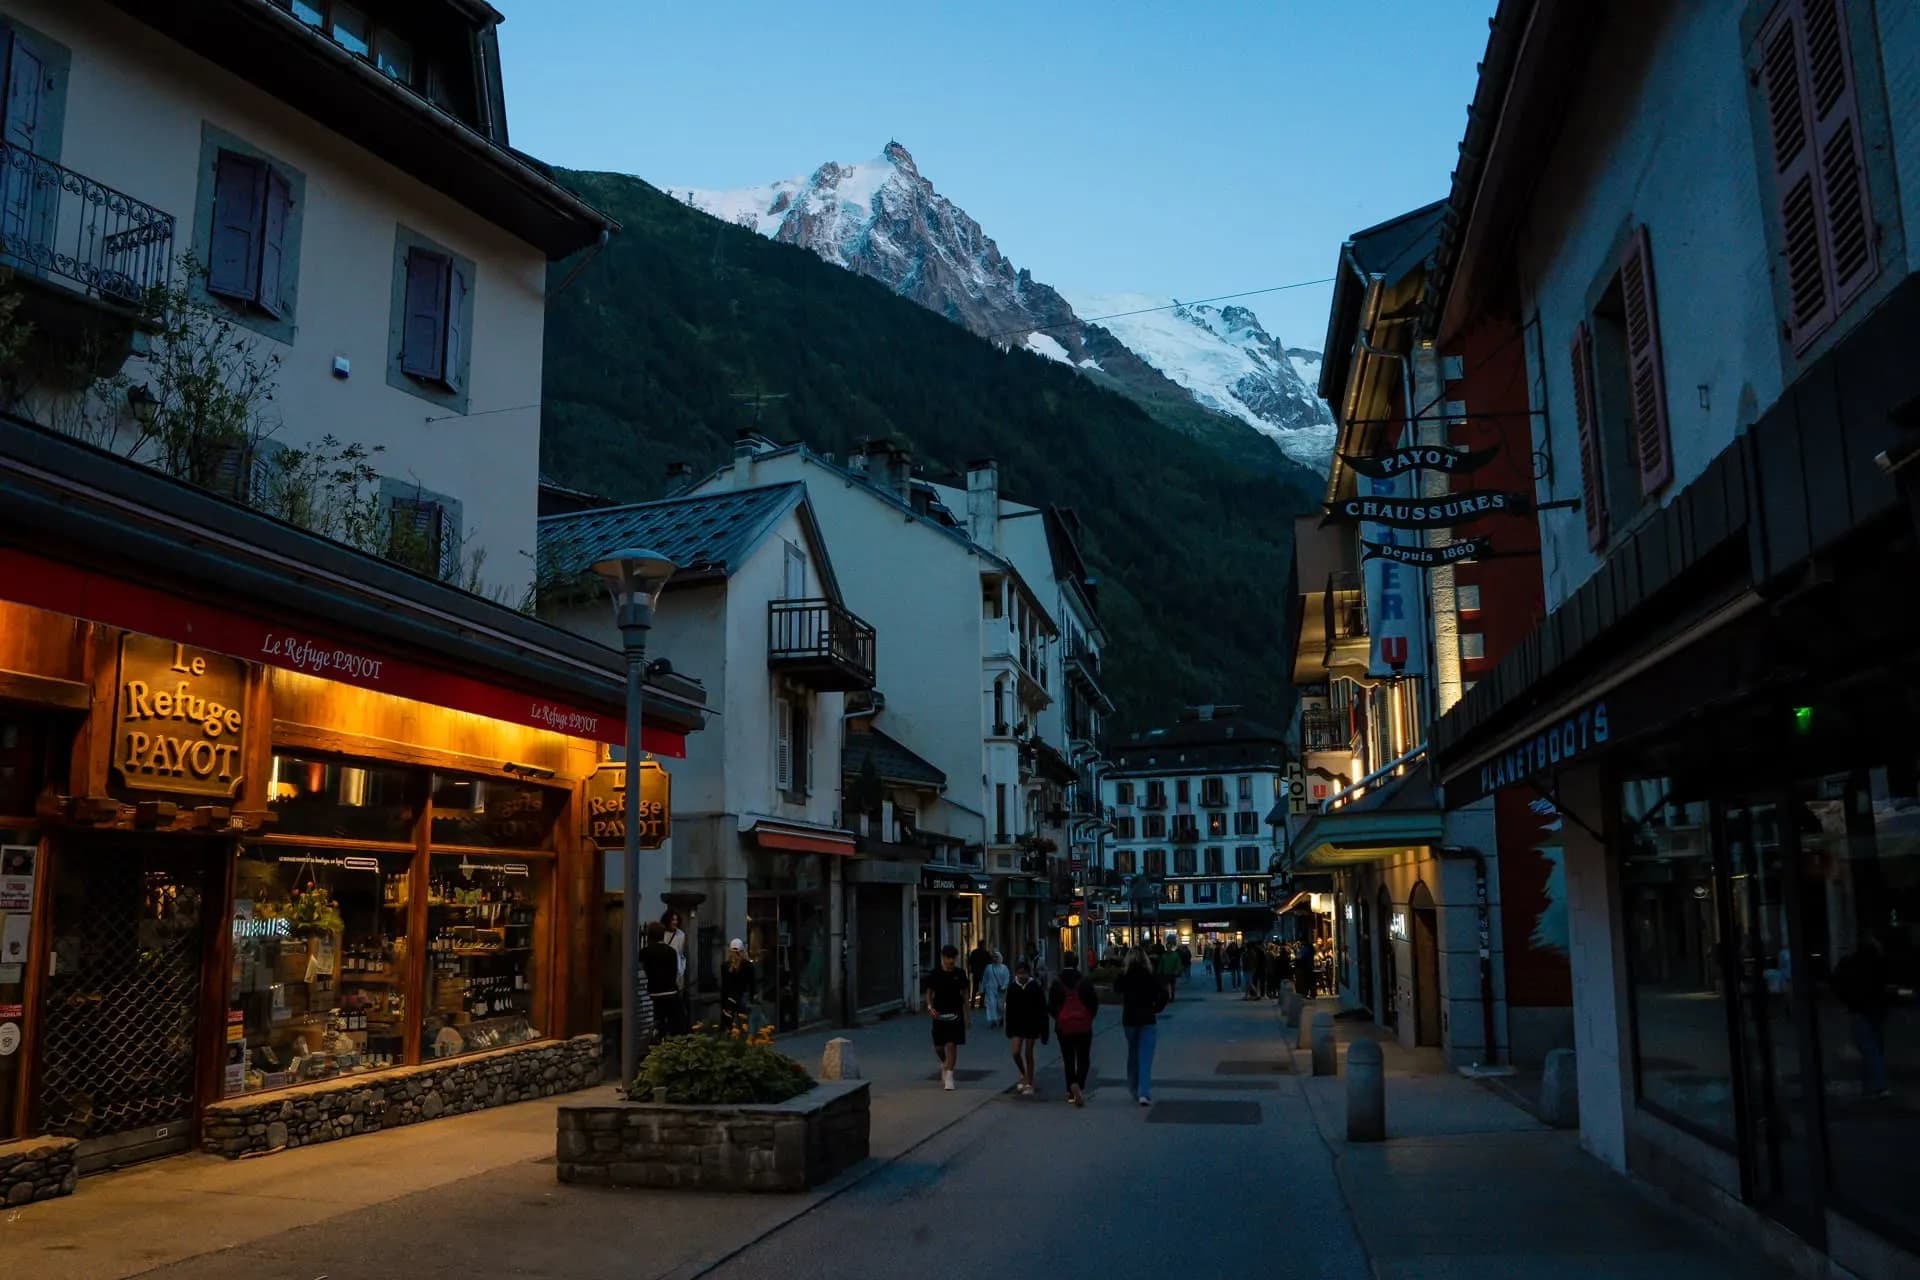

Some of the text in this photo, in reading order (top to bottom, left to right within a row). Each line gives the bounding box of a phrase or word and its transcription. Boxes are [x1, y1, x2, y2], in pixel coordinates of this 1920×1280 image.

[1381, 450, 1458, 473] PAYOT
[1344, 494, 1505, 521] CHAUSSURES
[1381, 542, 1476, 562] Depuis 1860
[172, 643, 206, 675] Le
[260, 633, 383, 680] Le Refuge PAYOT
[126, 680, 242, 737] Refuge
[530, 703, 598, 734] Le Refuge PAYOT
[126, 732, 239, 777] PAYOT
[591, 793, 662, 817] Refge
